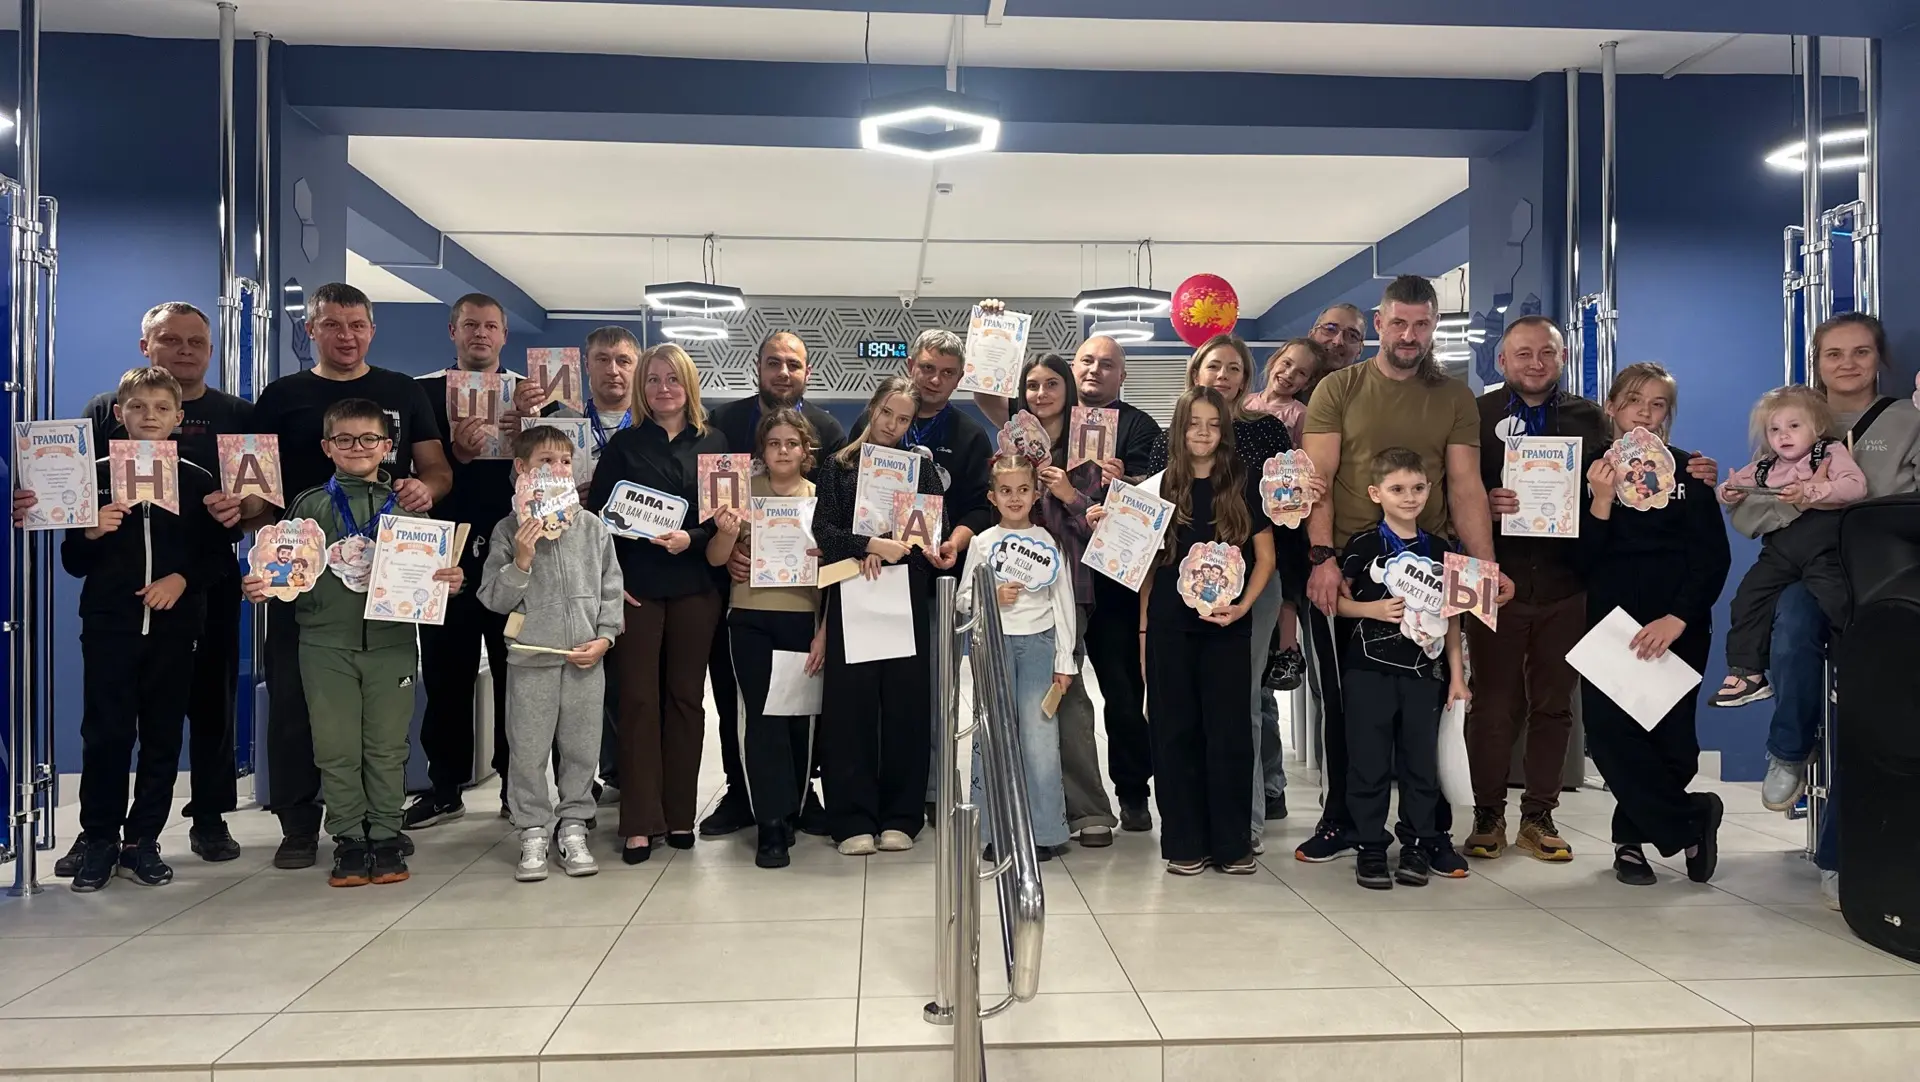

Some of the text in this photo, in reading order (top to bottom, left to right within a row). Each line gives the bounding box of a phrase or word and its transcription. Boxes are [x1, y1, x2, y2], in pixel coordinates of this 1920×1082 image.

[983, 318, 1016, 331] ГРАМОТА
[868, 342, 896, 357] 19:04
[539, 364, 571, 400] И
[450, 387, 496, 425] Ш
[32, 433, 76, 446] ГРАМОТА
[1078, 423, 1106, 460] П
[873, 457, 907, 472] ГРАМОТА
[1521, 449, 1565, 460] ГРАМОТА
[126, 459, 164, 499] Н
[232, 453, 272, 494] А
[625, 489, 663, 510] ПАПА
[709, 471, 739, 509] П
[611, 501, 678, 530] ЭТО ВАМ НЕ МАМА!
[1121, 494, 1156, 517] ГРАМОТА
[395, 529, 438, 543] ГРАМОТА
[901, 509, 931, 546] А
[1010, 542, 1051, 567] С ПАПОЙ
[1014, 557, 1033, 572] ВСЕГДА
[1395, 578, 1424, 599] МОЖЕТ
[1404, 563, 1443, 593] ПАПА
[1448, 569, 1492, 615] Ы
